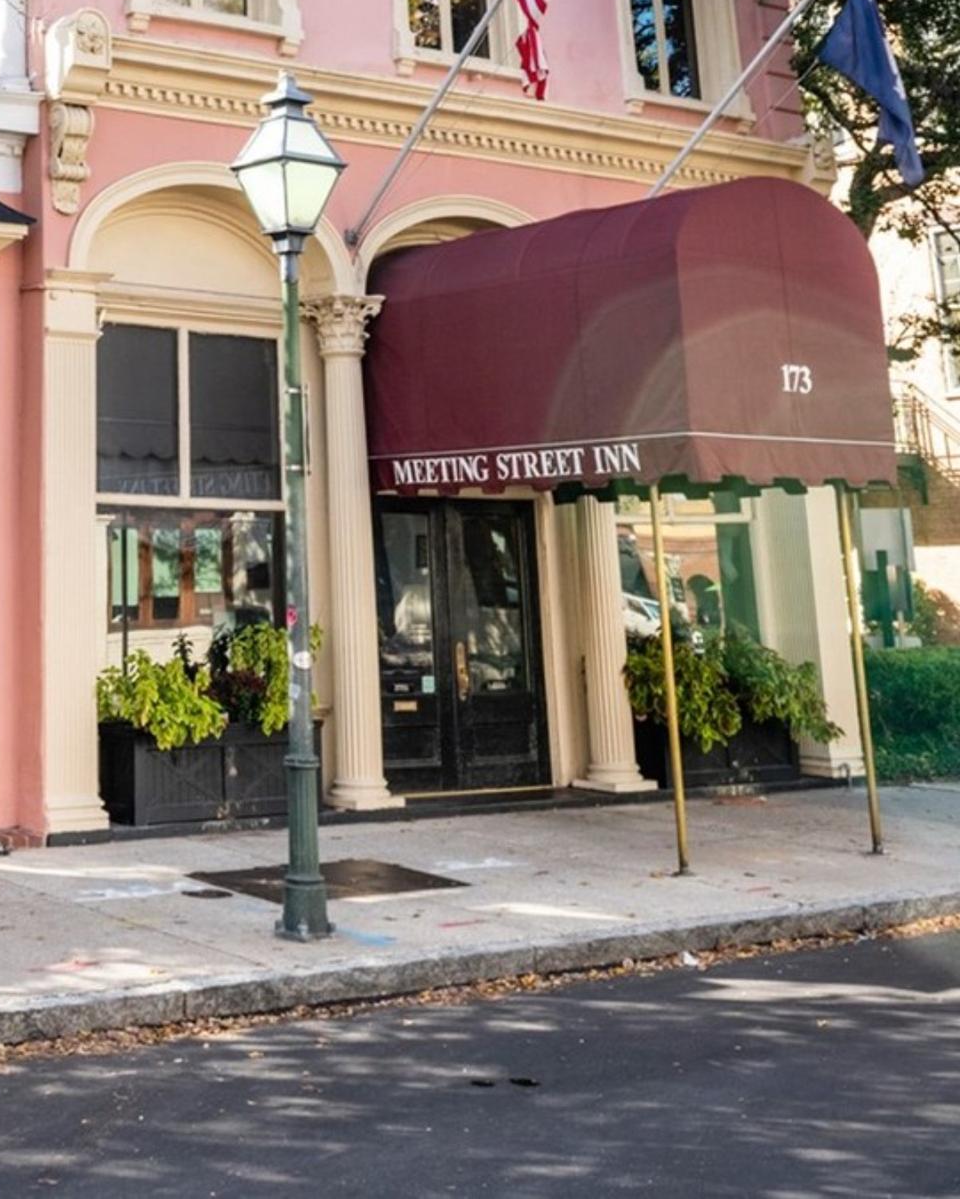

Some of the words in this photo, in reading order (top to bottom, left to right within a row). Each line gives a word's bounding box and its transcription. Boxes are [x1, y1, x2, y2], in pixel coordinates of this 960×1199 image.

[781, 364, 812, 394] 173
[392, 455, 489, 486] MEETING
[496, 448, 585, 480] STREET
[594, 443, 642, 475] INN
